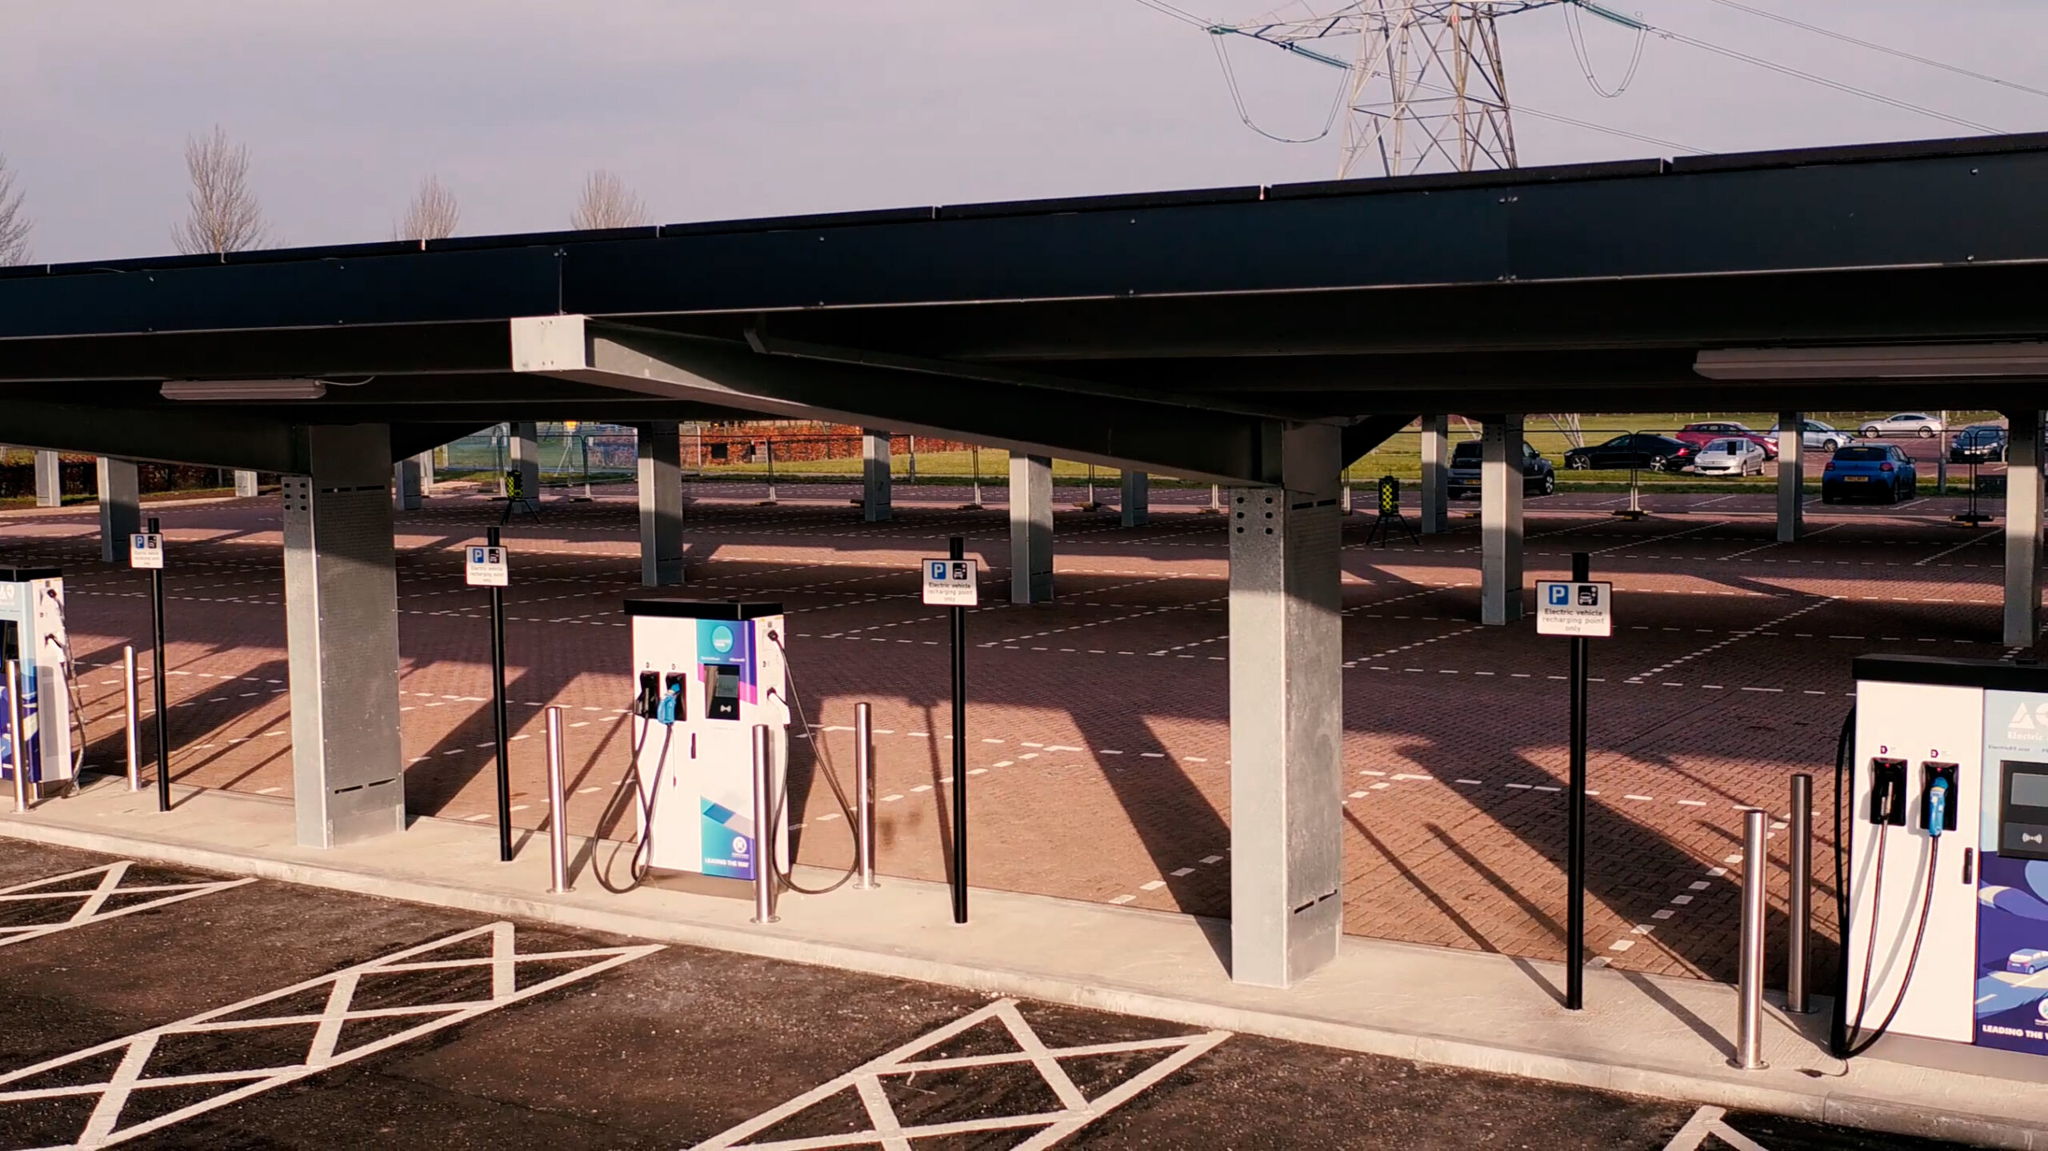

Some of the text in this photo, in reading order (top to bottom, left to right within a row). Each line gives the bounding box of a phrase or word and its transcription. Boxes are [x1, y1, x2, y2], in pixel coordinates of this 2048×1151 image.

[933, 563, 944, 578] P
[1552, 586, 1566, 604] P
[1544, 608, 1573, 616] Electric
[1542, 616, 1582, 624] recharging
[2007, 731, 2044, 741] Electric
[1982, 1024, 2024, 1037] LEADING
[2025, 1029, 2043, 1040] THE
